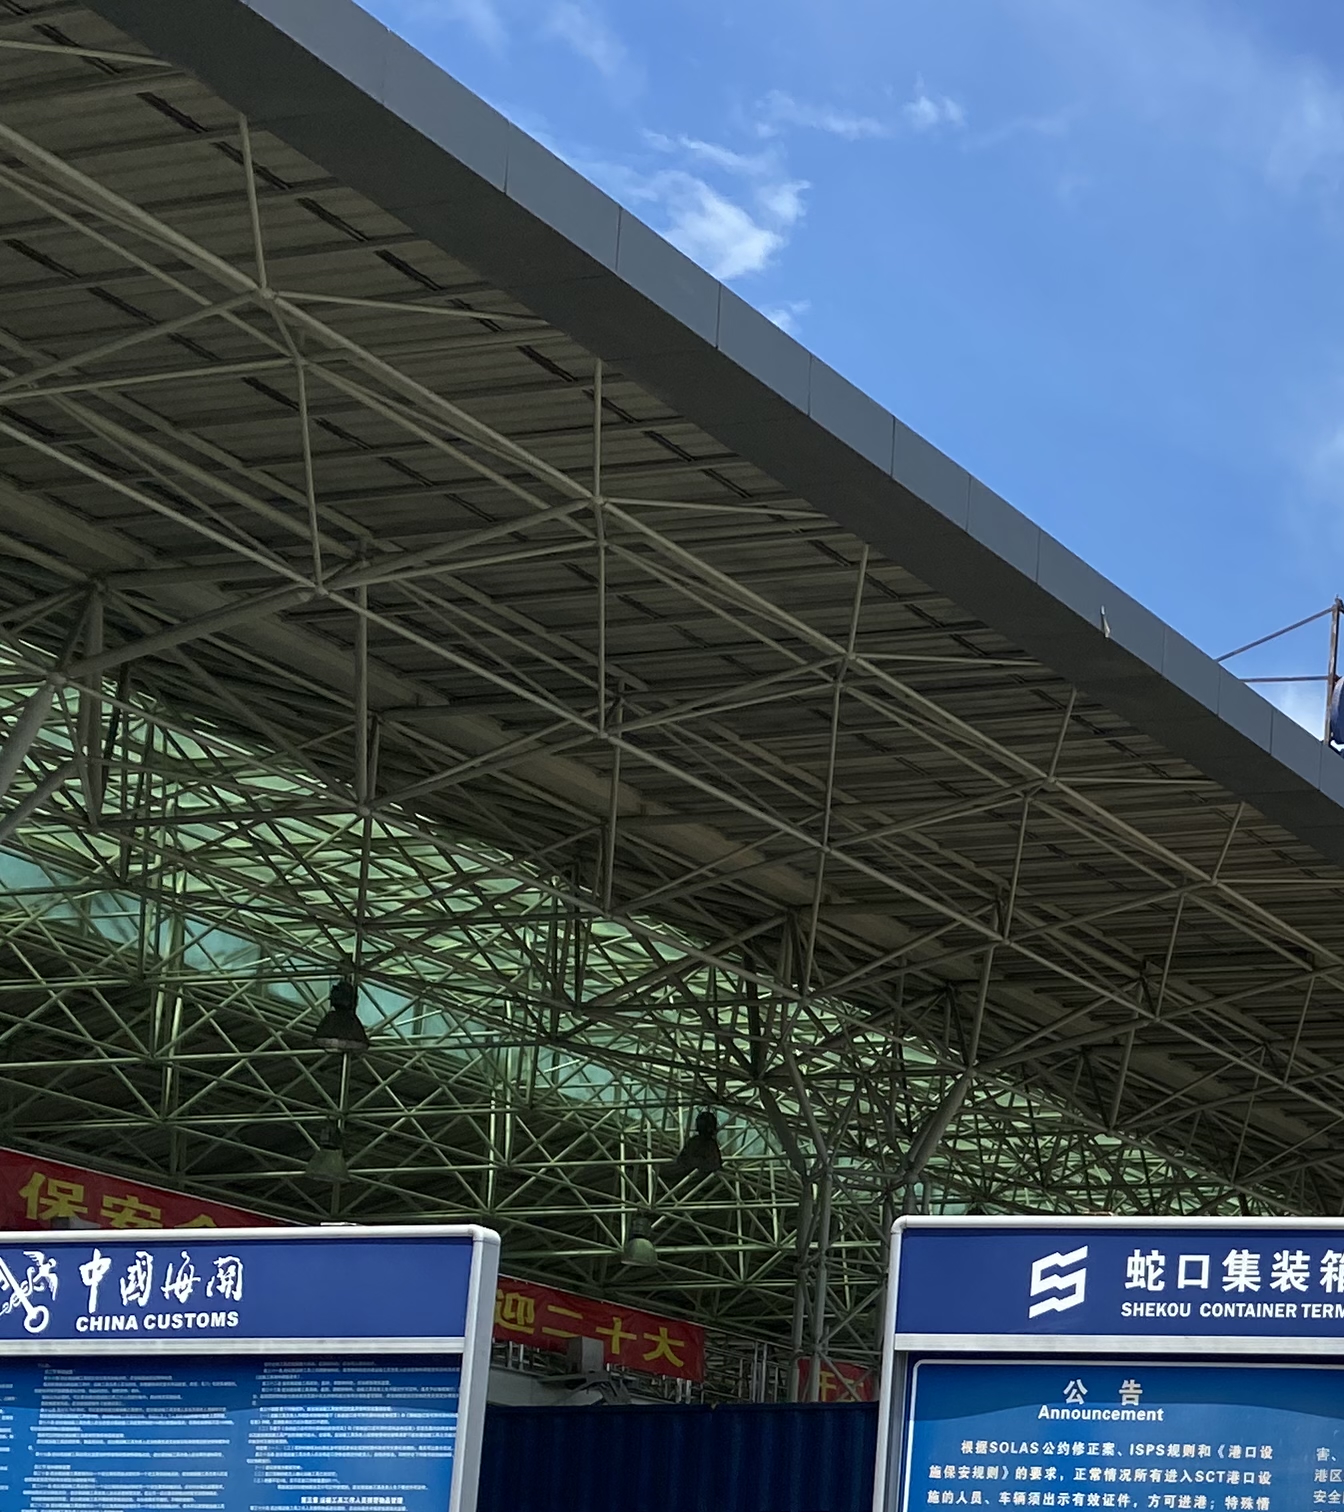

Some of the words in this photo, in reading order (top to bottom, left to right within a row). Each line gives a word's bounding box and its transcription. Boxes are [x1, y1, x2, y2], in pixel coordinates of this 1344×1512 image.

[19, 1171, 217, 1229] 保安
[1121, 1302, 1191, 1317] SHEKOU
[1200, 1303, 1297, 1317] CONTAINER
[76, 1315, 138, 1331] CHINA
[143, 1311, 239, 1329] CUSTOMS
[1038, 1405, 1164, 1421] Announcement
